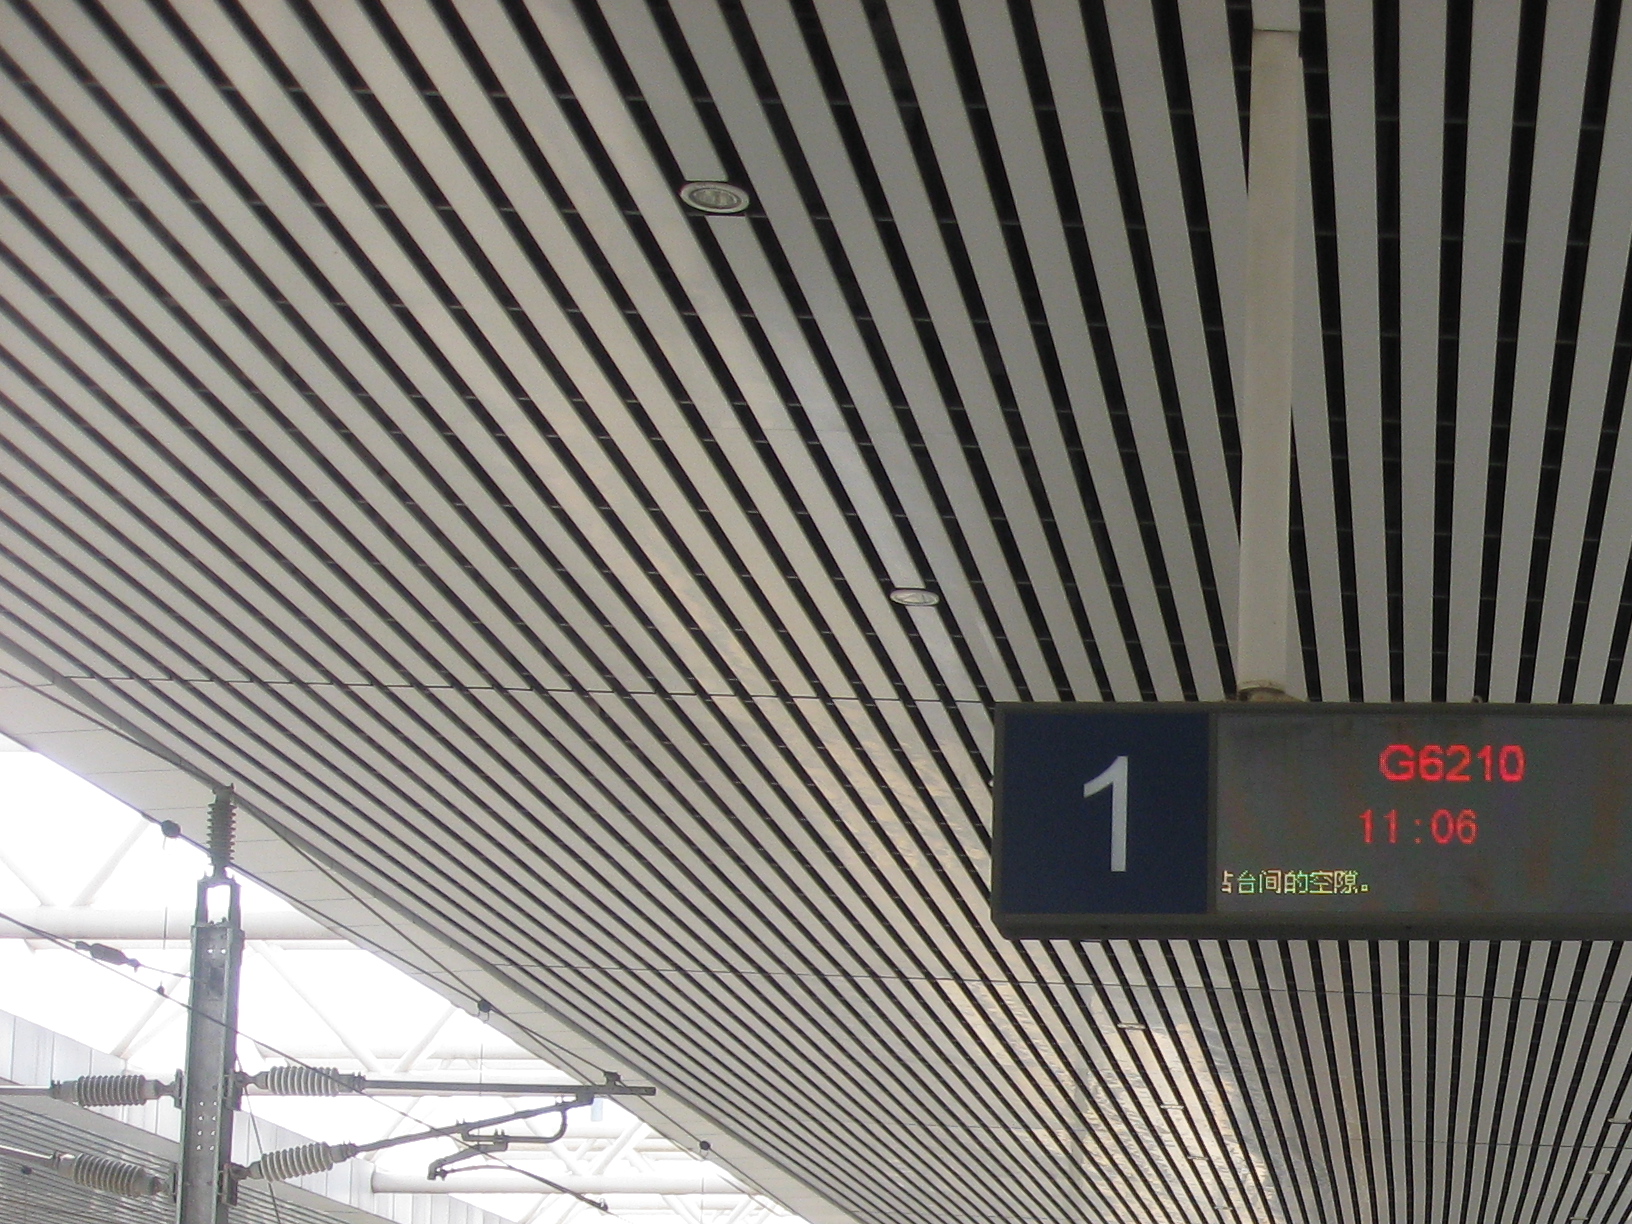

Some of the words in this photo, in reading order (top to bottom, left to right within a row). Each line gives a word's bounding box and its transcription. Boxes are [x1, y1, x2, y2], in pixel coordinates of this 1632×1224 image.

[1378, 744, 1527, 782] G6210
[1083, 755, 1128, 872] 1
[1359, 808, 1479, 845] 11:06
